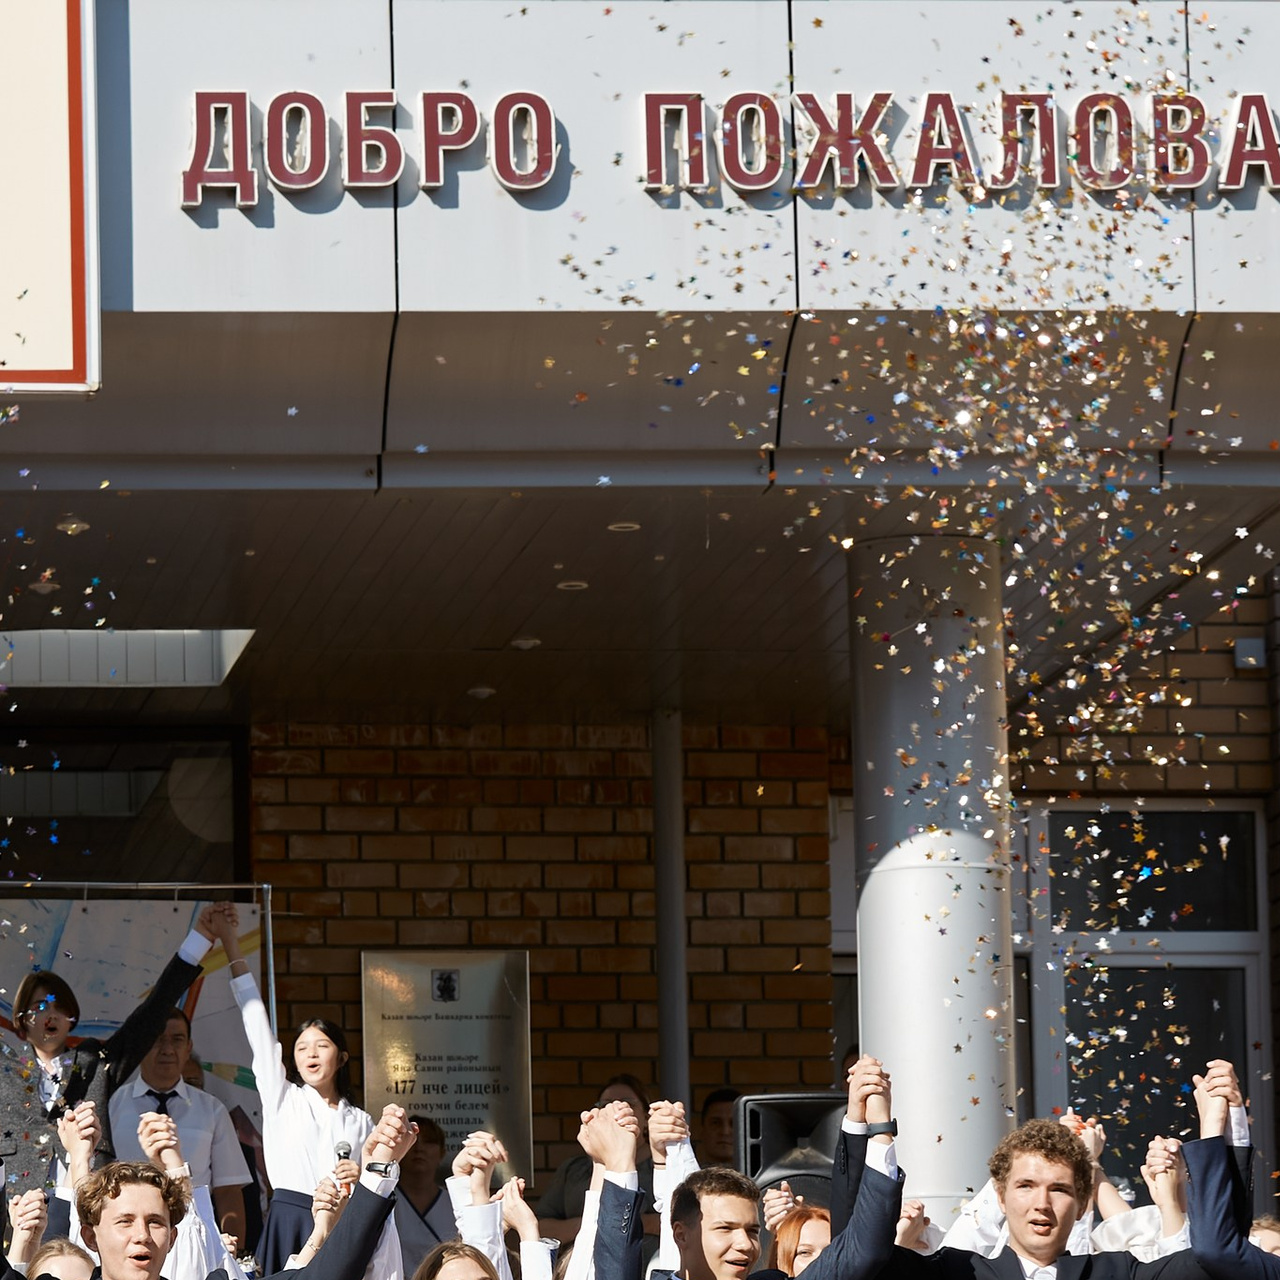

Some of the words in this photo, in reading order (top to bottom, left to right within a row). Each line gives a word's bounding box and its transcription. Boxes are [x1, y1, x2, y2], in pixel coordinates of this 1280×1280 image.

[181, 91, 561, 207] ДОБРО
[643, 91, 1280, 189] ПОЖАЛОВА
[386, 1080, 416, 1095] «177
[422, 1085, 449, 1095] нче
[408, 1103, 451, 1113] гомуми
[455, 1100, 489, 1111] белем
